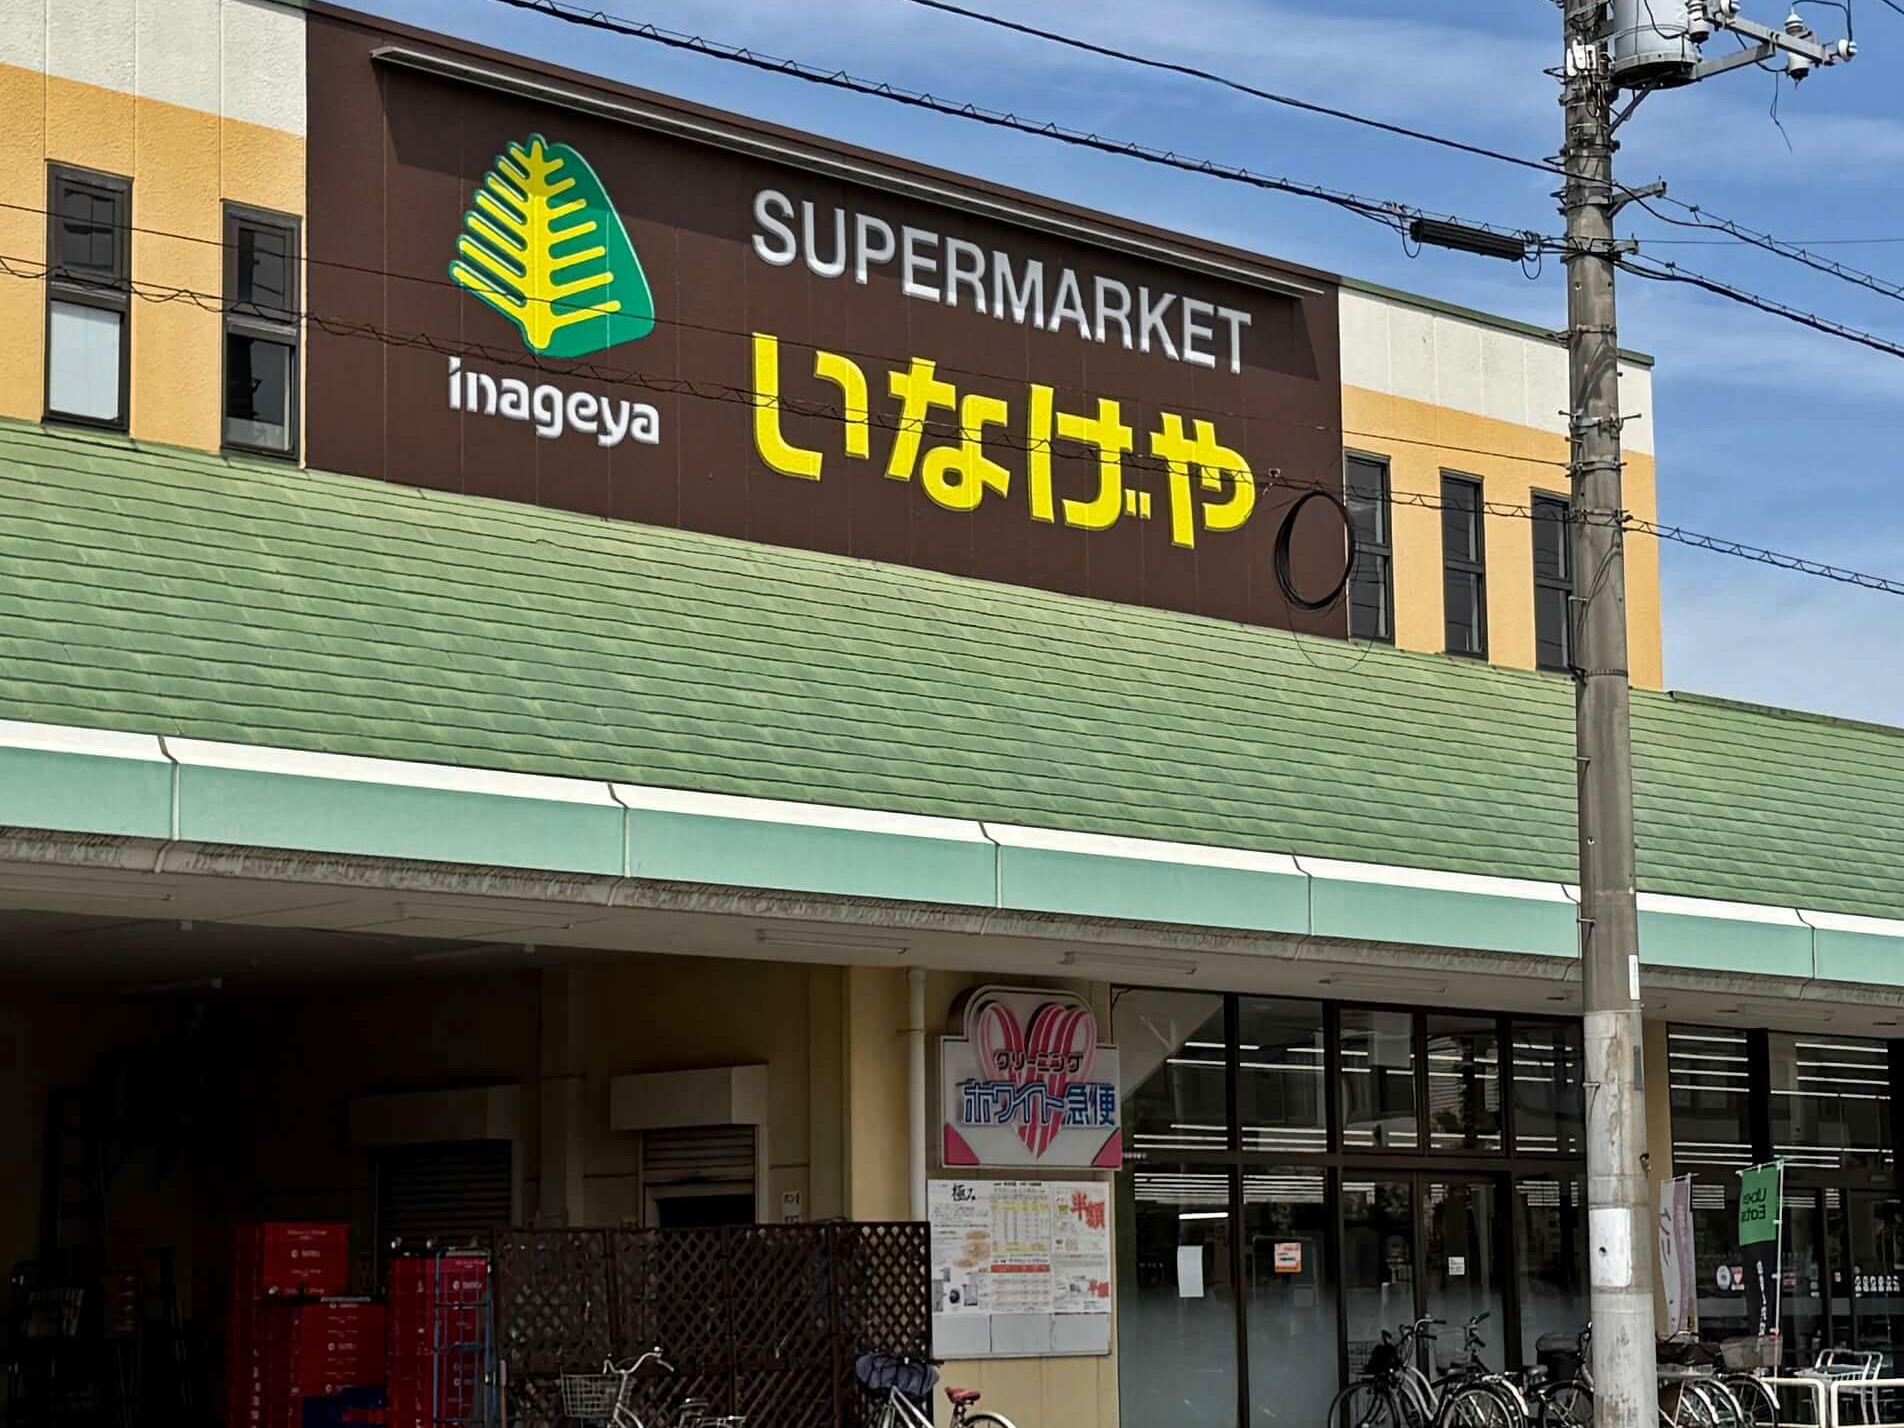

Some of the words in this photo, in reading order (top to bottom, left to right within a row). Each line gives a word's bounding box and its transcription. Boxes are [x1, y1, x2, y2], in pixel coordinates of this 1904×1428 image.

[751, 188, 1251, 374] SUPERMARKET
[448, 356, 661, 449] inageya
[751, 331, 1256, 549] いなげや
[964, 1082, 1116, 1126] ホワイト急便
[994, 1051, 1084, 1073] クリーニング
